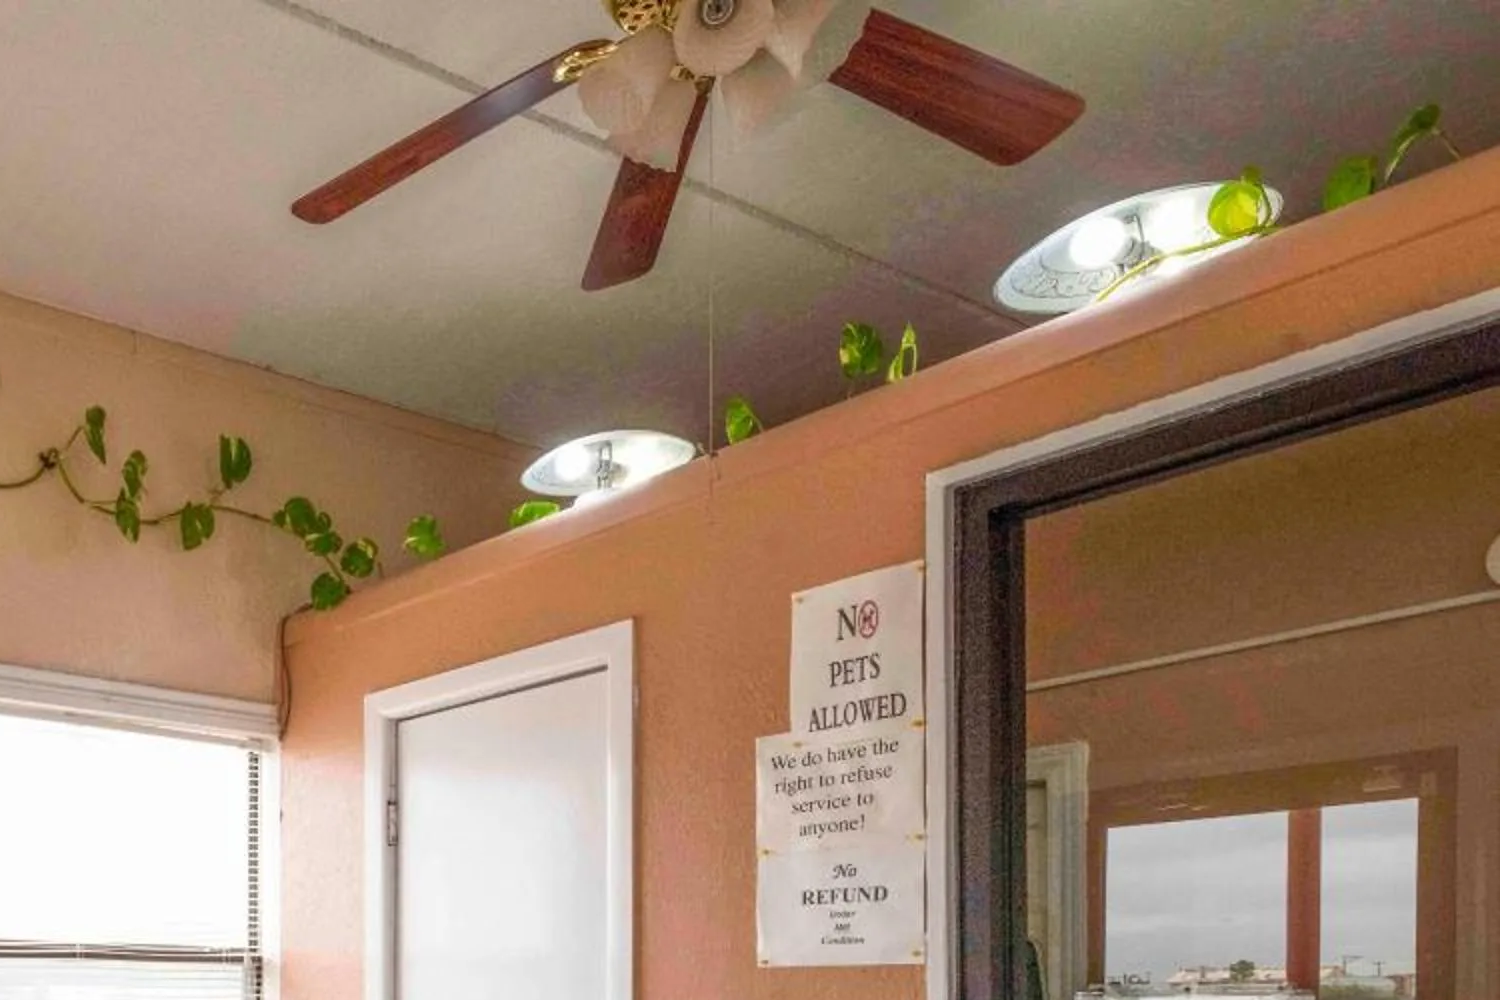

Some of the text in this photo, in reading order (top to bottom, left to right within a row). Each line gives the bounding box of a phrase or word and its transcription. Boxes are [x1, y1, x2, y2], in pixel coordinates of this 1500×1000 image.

[829, 652, 881, 688] PETS
[809, 692, 907, 732] ALLOWED
[772, 739, 900, 770] We do have the
[775, 766, 893, 797] right to refuse
[792, 793, 874, 814] service to
[799, 814, 865, 838] anyone!
[832, 863, 857, 879] No
[802, 885, 889, 906] REFUND
